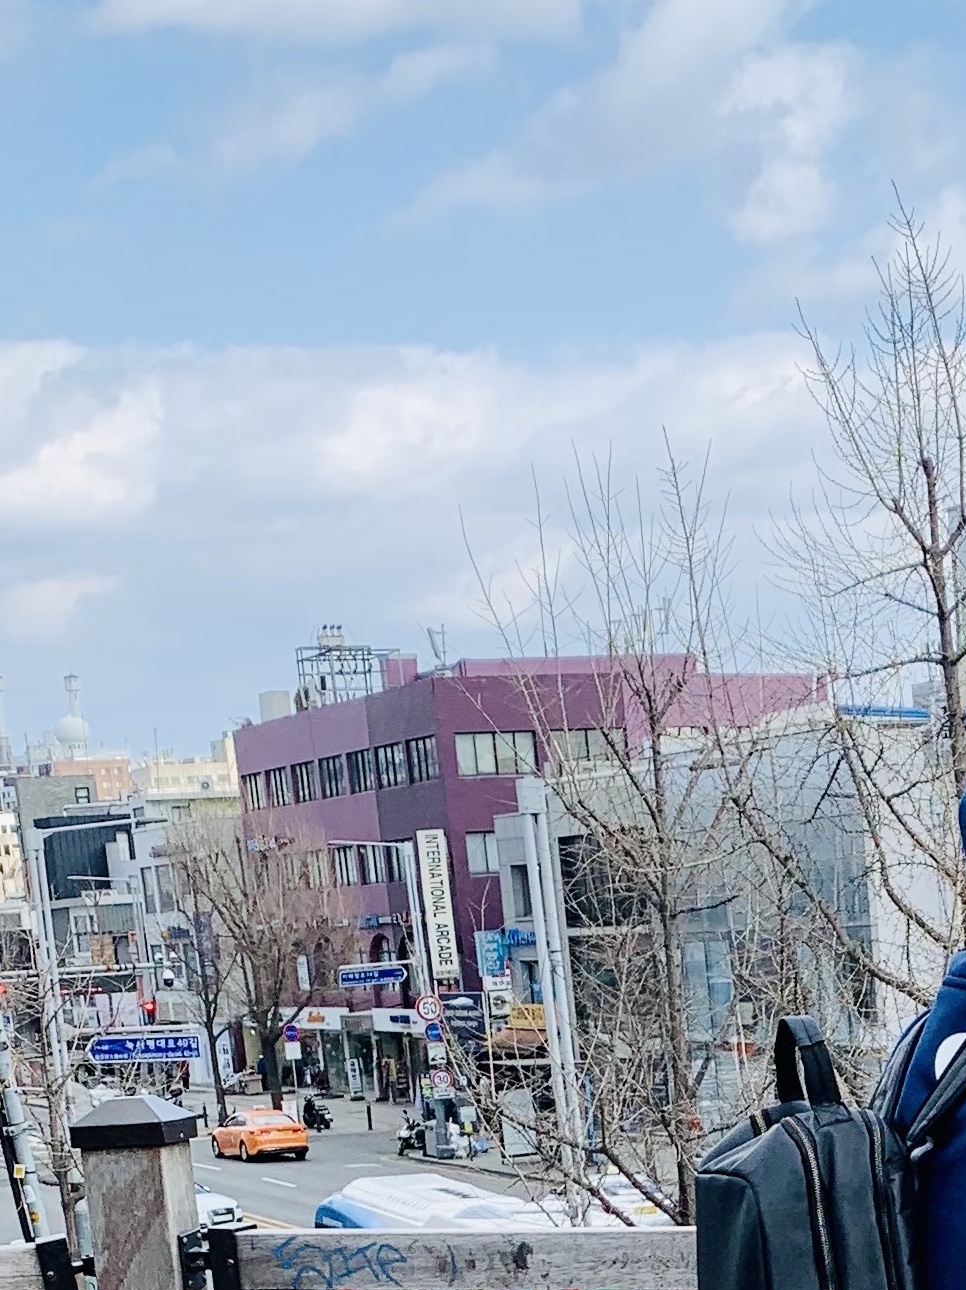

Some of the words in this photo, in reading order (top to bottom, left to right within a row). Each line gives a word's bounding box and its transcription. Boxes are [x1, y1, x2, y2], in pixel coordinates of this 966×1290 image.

[424, 834, 448, 918] INTERNATIONAL
[435, 923, 454, 967] ARCADE
[422, 1002, 437, 1015] 50
[436, 1074, 449, 1085] 30
